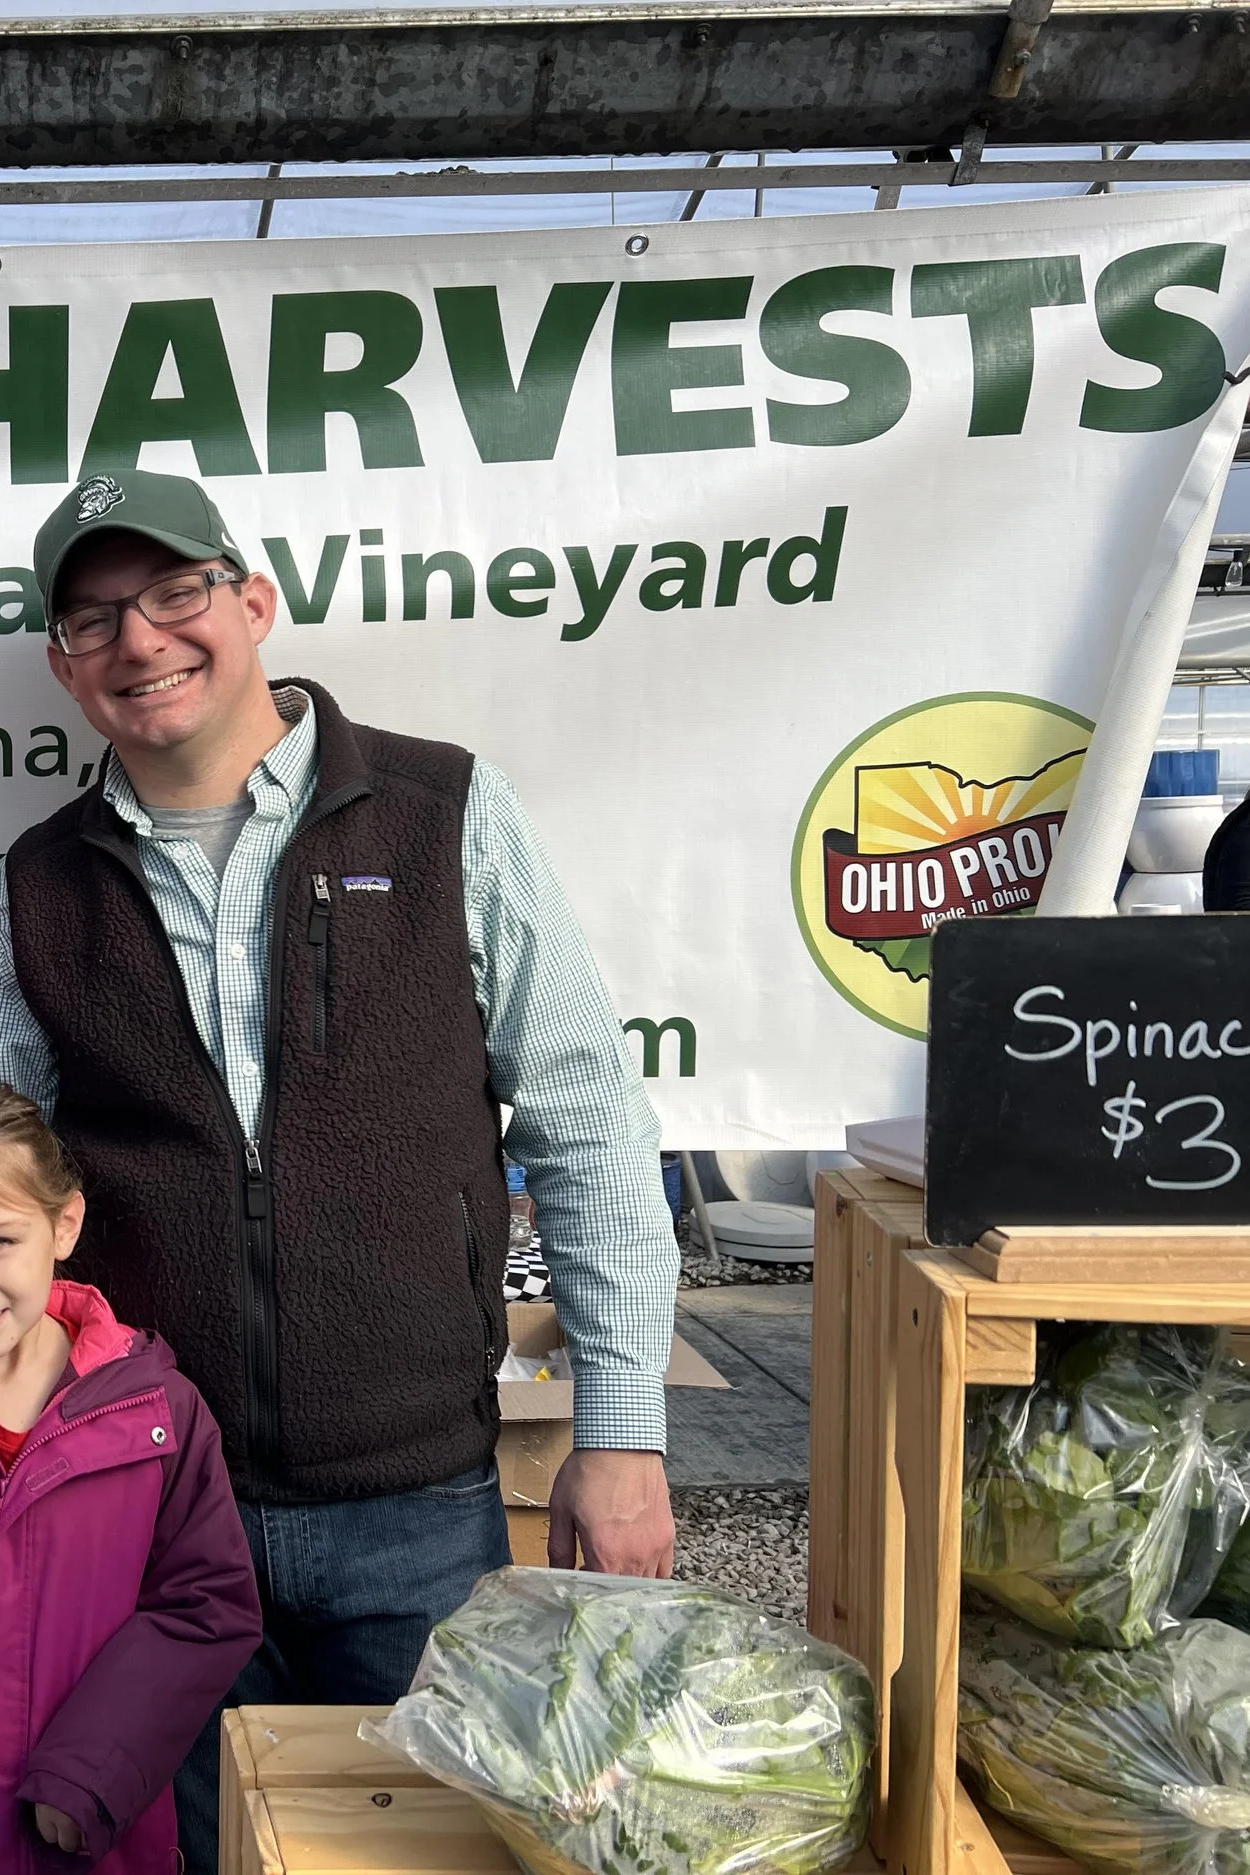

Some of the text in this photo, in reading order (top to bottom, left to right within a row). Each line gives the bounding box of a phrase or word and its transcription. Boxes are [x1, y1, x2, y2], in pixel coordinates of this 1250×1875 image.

[261, 506, 848, 642] Vineyard
[841, 858, 946, 914] OHIO
[971, 899, 989, 915] in
[992, 886, 1031, 908] Ohio
[1101, 1080, 1242, 1190] $3
